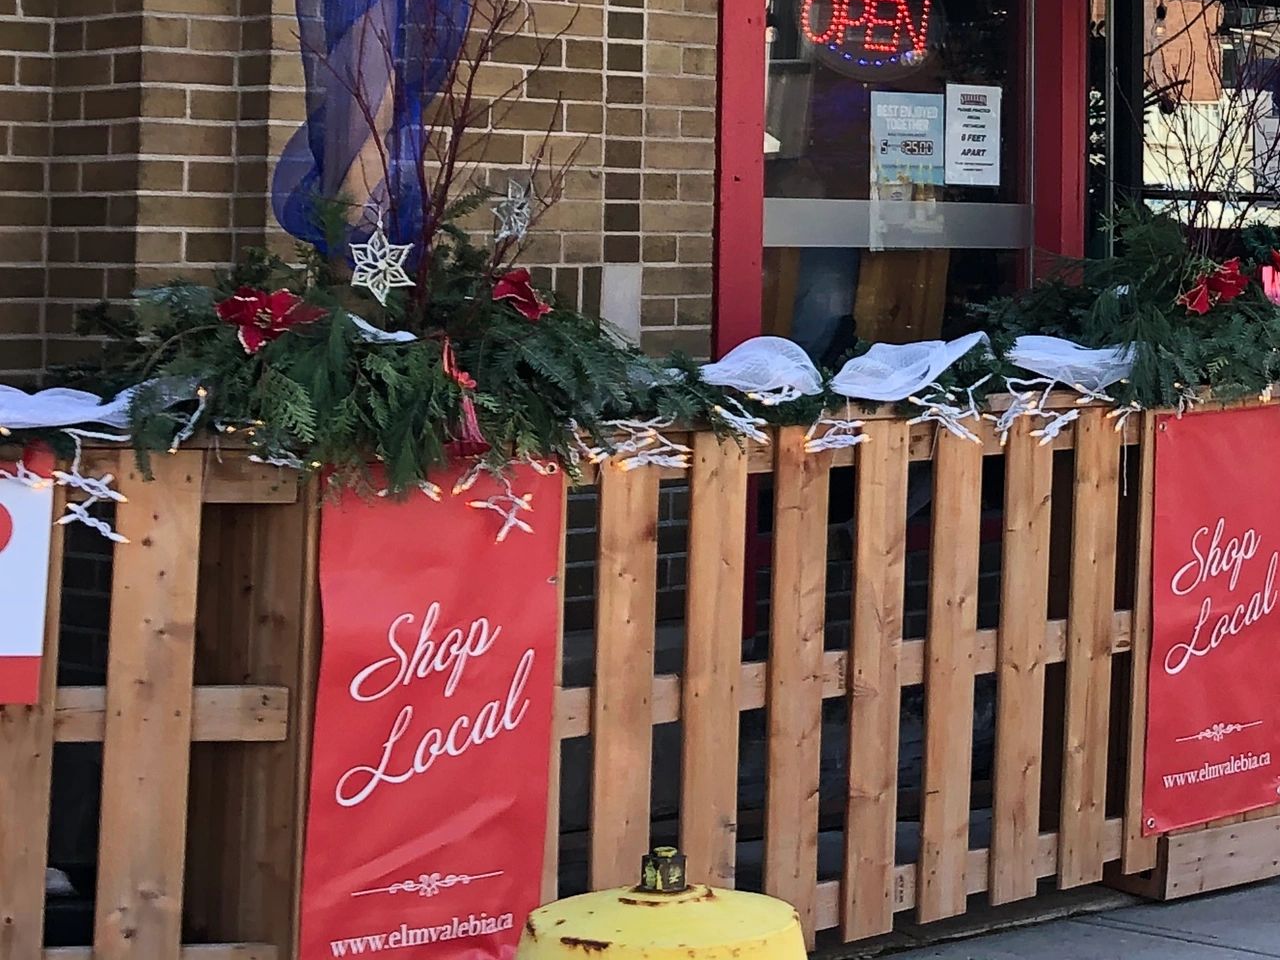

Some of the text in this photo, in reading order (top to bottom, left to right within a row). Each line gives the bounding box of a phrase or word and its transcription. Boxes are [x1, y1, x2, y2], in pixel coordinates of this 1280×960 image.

[961, 148, 987, 156] APART
[1171, 517, 1262, 597] Shop
[349, 601, 503, 703] Shop
[1164, 551, 1279, 675] Local
[335, 648, 535, 808] Local
[1162, 752, 1271, 789] www.elmvalebia.ca
